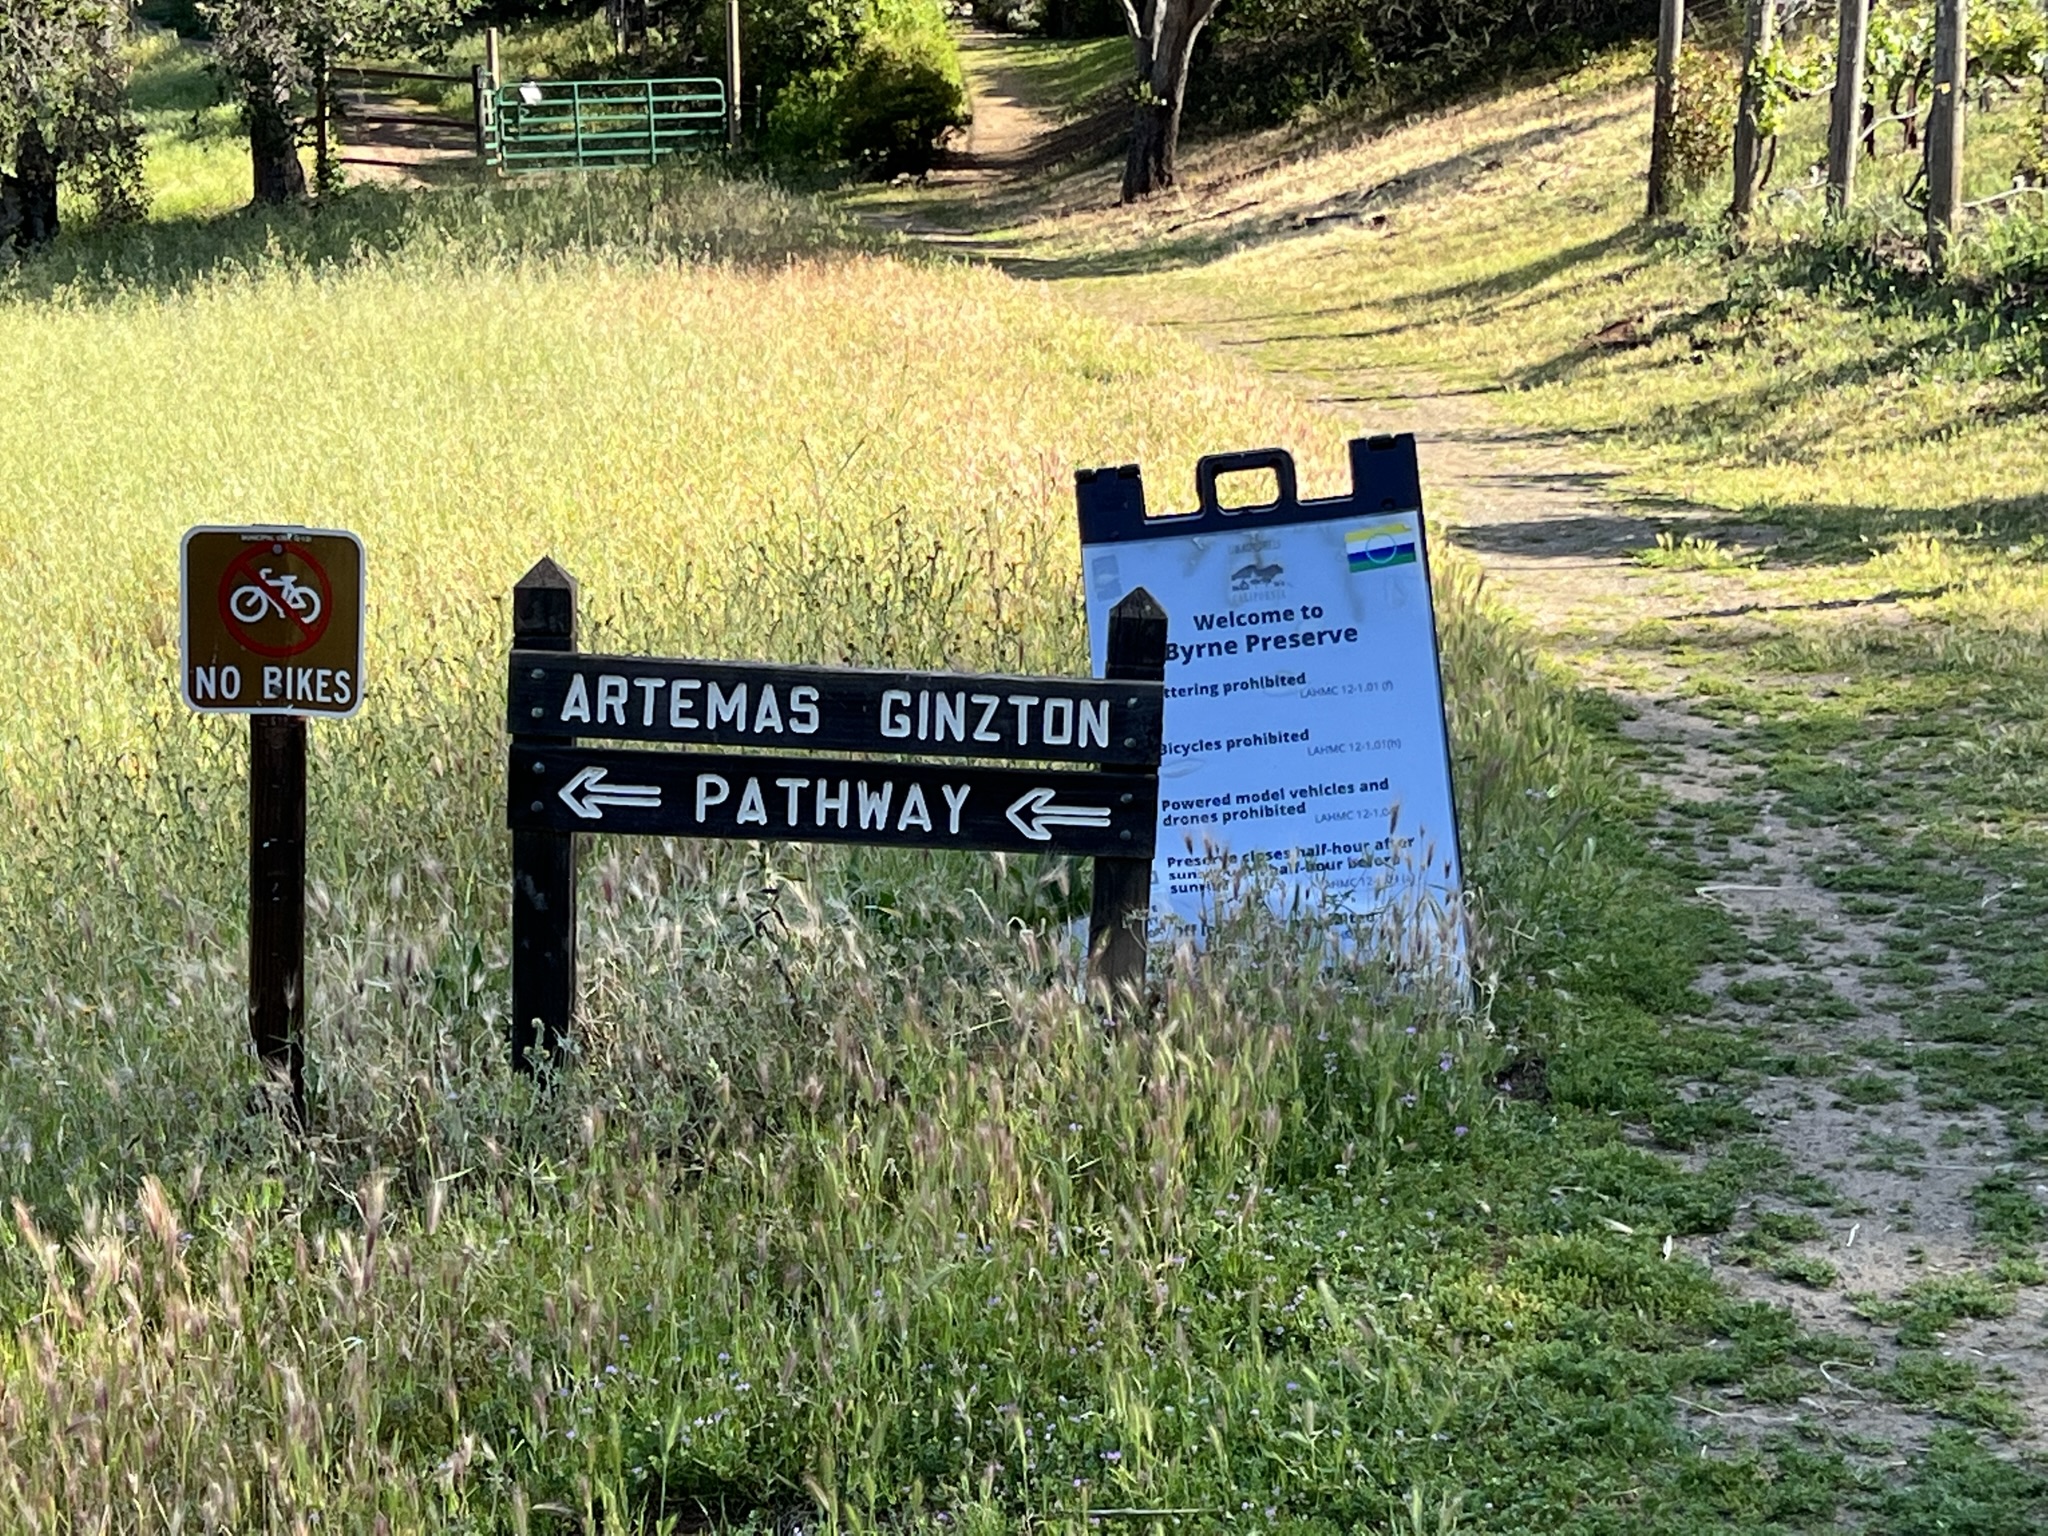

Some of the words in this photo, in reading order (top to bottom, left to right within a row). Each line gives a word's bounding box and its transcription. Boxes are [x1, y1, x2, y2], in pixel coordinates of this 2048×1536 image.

[1193, 608, 1295, 631] Welcome
[1300, 605, 1324, 620] to
[1165, 640, 1238, 665] Byrne
[1245, 627, 1358, 653] Preserve
[195, 665, 241, 700] NO
[263, 665, 351, 704] BIKES
[1164, 682, 1220, 699] ttering
[1222, 672, 1307, 696] prohibited
[1300, 686, 1339, 698] LAHMC
[560, 673, 819, 735] ARTEMAS
[880, 689, 1110, 749] GINZTON
[1159, 739, 1222, 757] Bicycles
[1226, 729, 1310, 752] prohibited
[1307, 744, 1346, 756] LAHMC
[696, 773, 971, 834] PATHWAY
[1162, 793, 1231, 811] Powered
[1236, 787, 1285, 804] model
[1290, 781, 1354, 799] vehicles
[1359, 778, 1389, 793] and
[1163, 811, 1218, 827] drones
[1222, 802, 1306, 825] prohibited
[1314, 811, 1353, 823] LAHMC
[1375, 837, 1414, 851] afer
